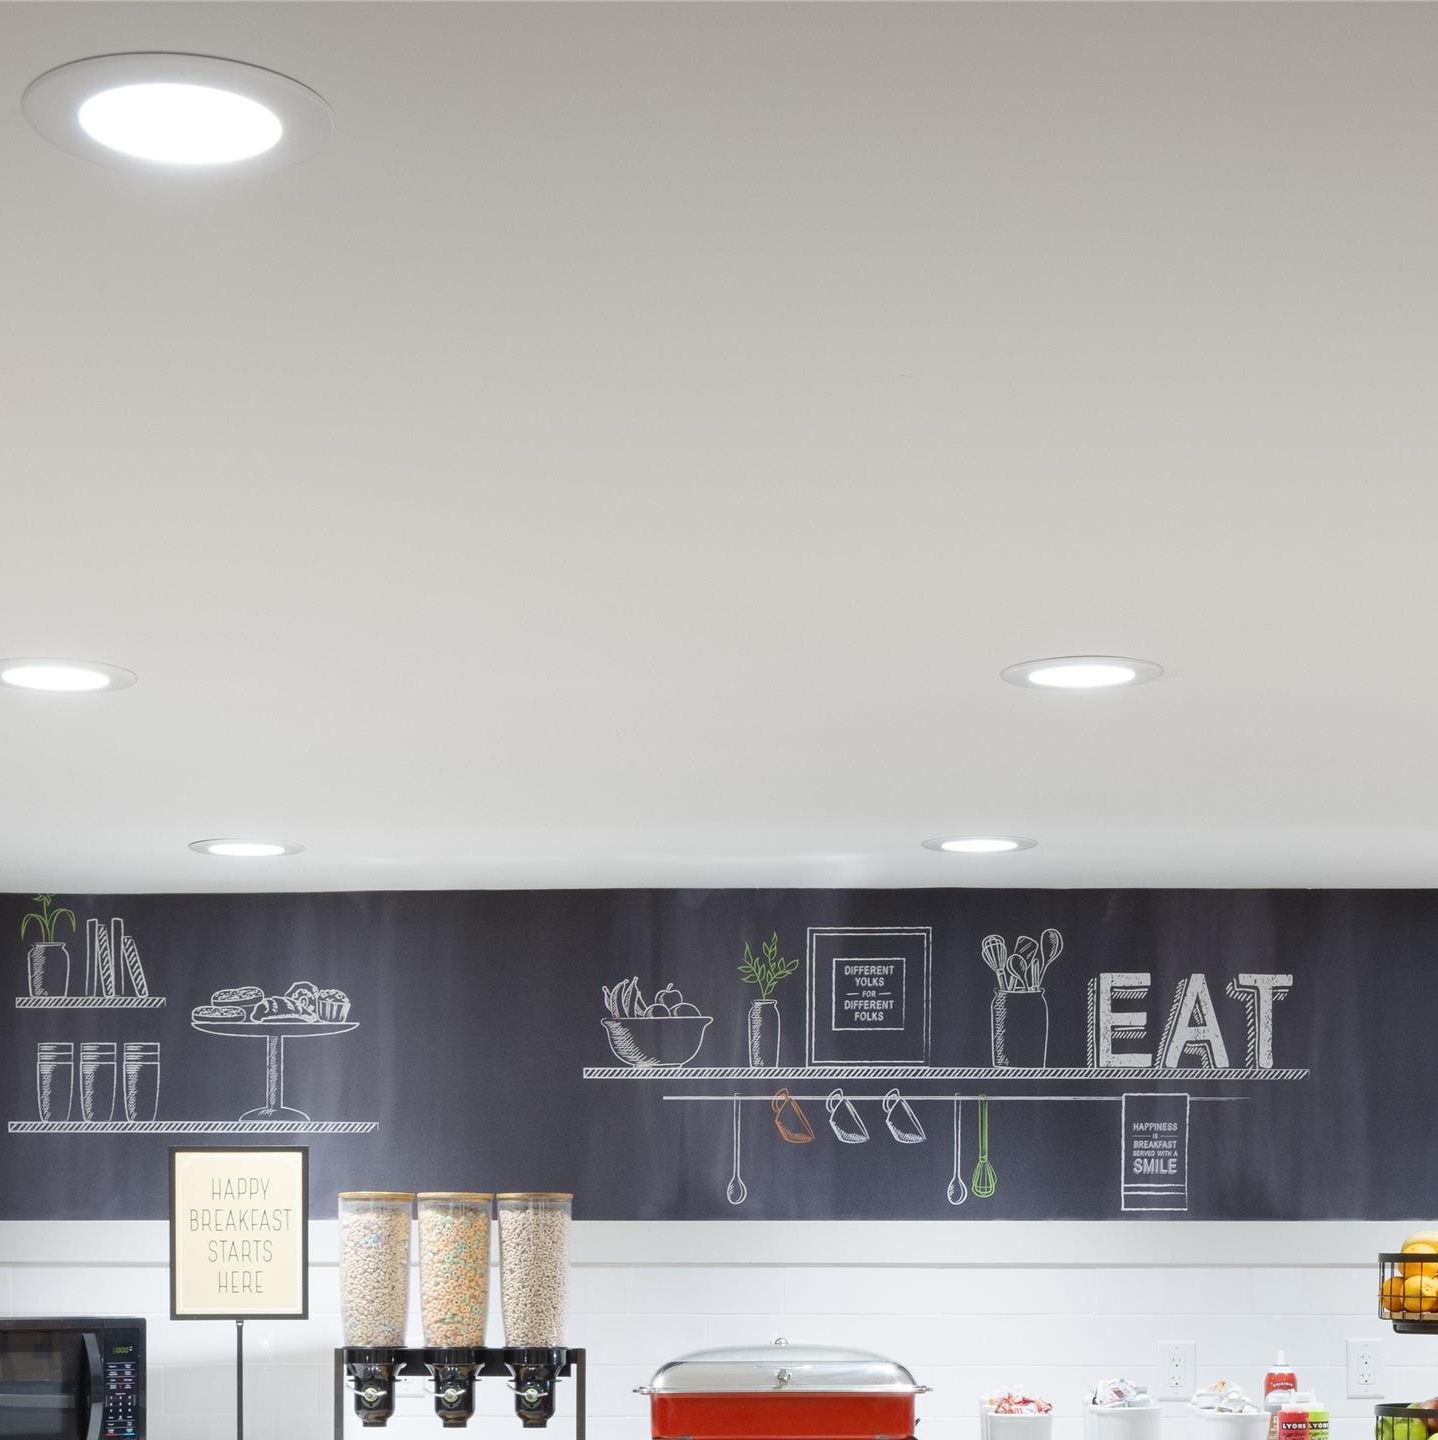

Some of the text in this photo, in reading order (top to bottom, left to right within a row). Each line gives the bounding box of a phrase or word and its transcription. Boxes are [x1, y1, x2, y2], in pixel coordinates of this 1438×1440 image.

[844, 965, 895, 976] DIFFERENT
[854, 977, 885, 987] YOLKS
[862, 990, 877, 998] FOR
[844, 1000, 895, 1010] DIFFERENT
[854, 1011, 884, 1022] FOLKS
[1087, 972, 1294, 1070] EAT
[1133, 1122, 1178, 1132] HAPPINESS
[1133, 1140, 1178, 1149] BREAKFAST
[1133, 1158, 1178, 1175] SMILE
[211, 1177, 271, 1201] HAPPY
[189, 1208, 293, 1232] BREAKFAST
[208, 1239, 273, 1263] STARTS
[218, 1270, 265, 1294] HERE
